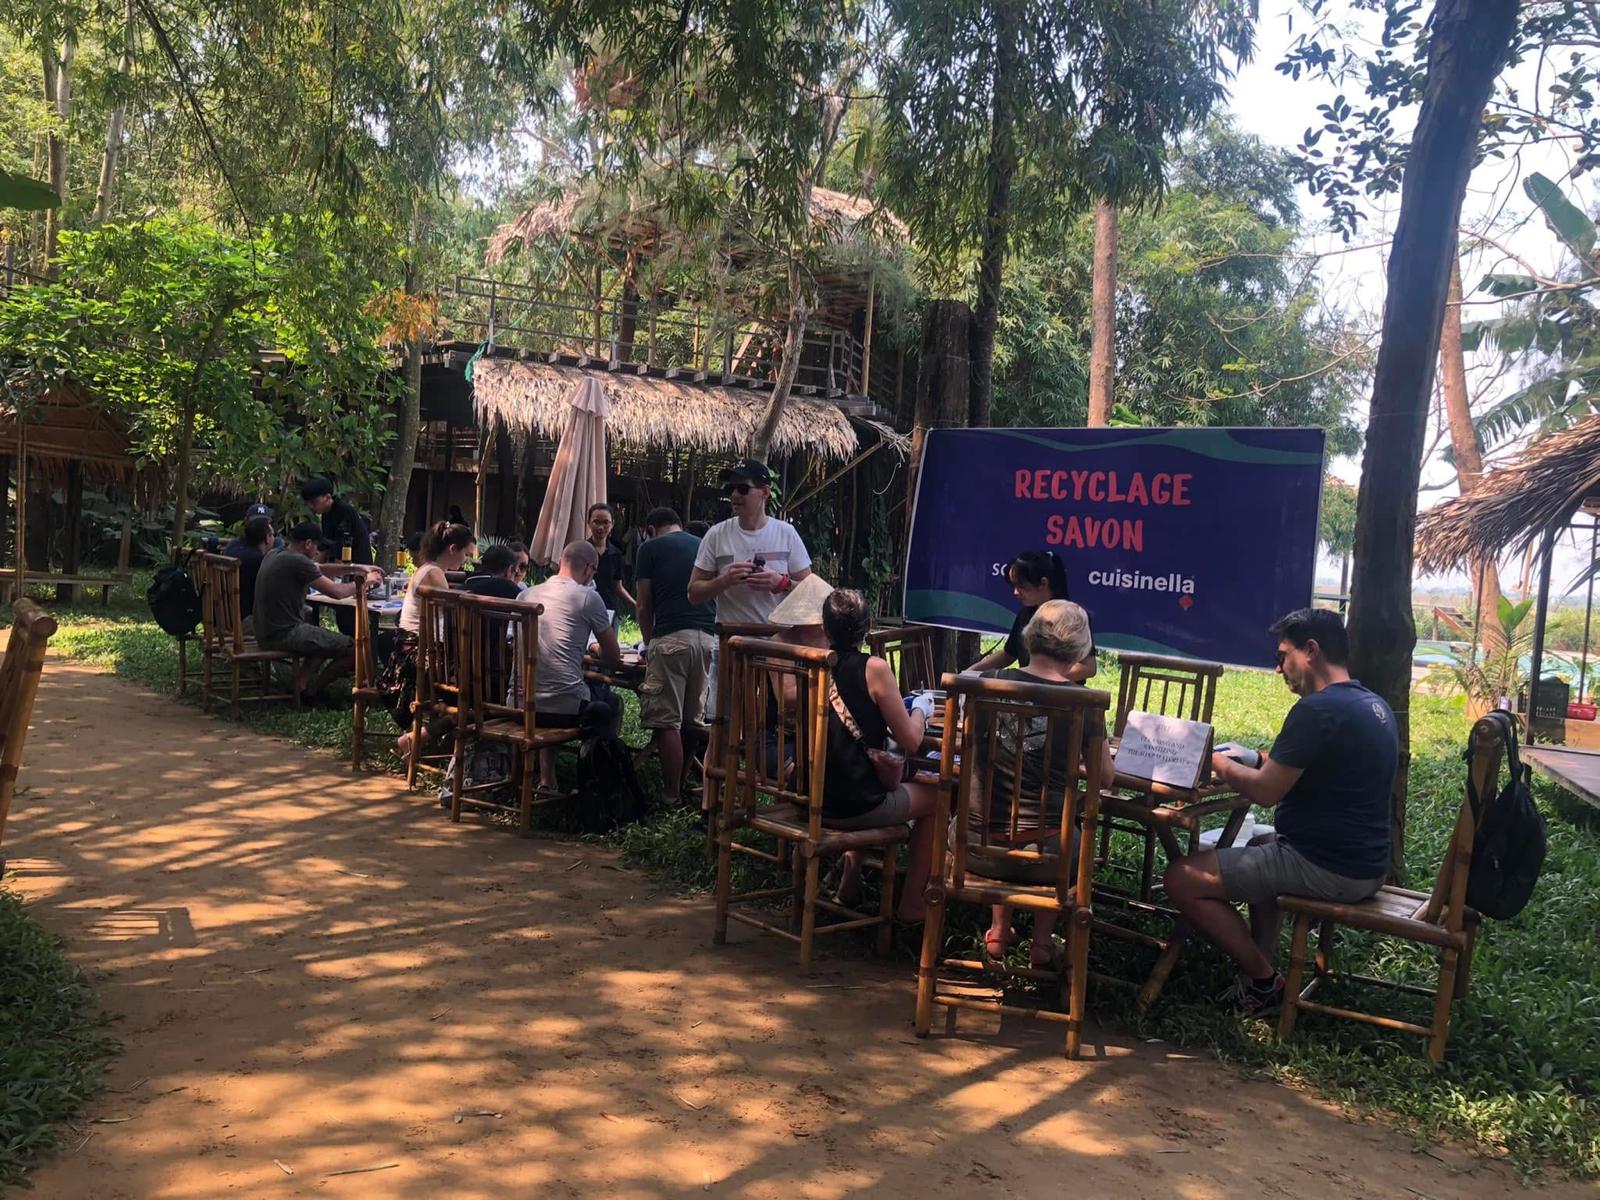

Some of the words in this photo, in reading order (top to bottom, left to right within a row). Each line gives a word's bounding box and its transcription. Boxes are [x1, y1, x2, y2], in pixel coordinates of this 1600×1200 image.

[1015, 469, 1192, 506] RECYCLAGE
[1046, 515, 1143, 551] SAVON
[1088, 569, 1195, 594] cuisinella
